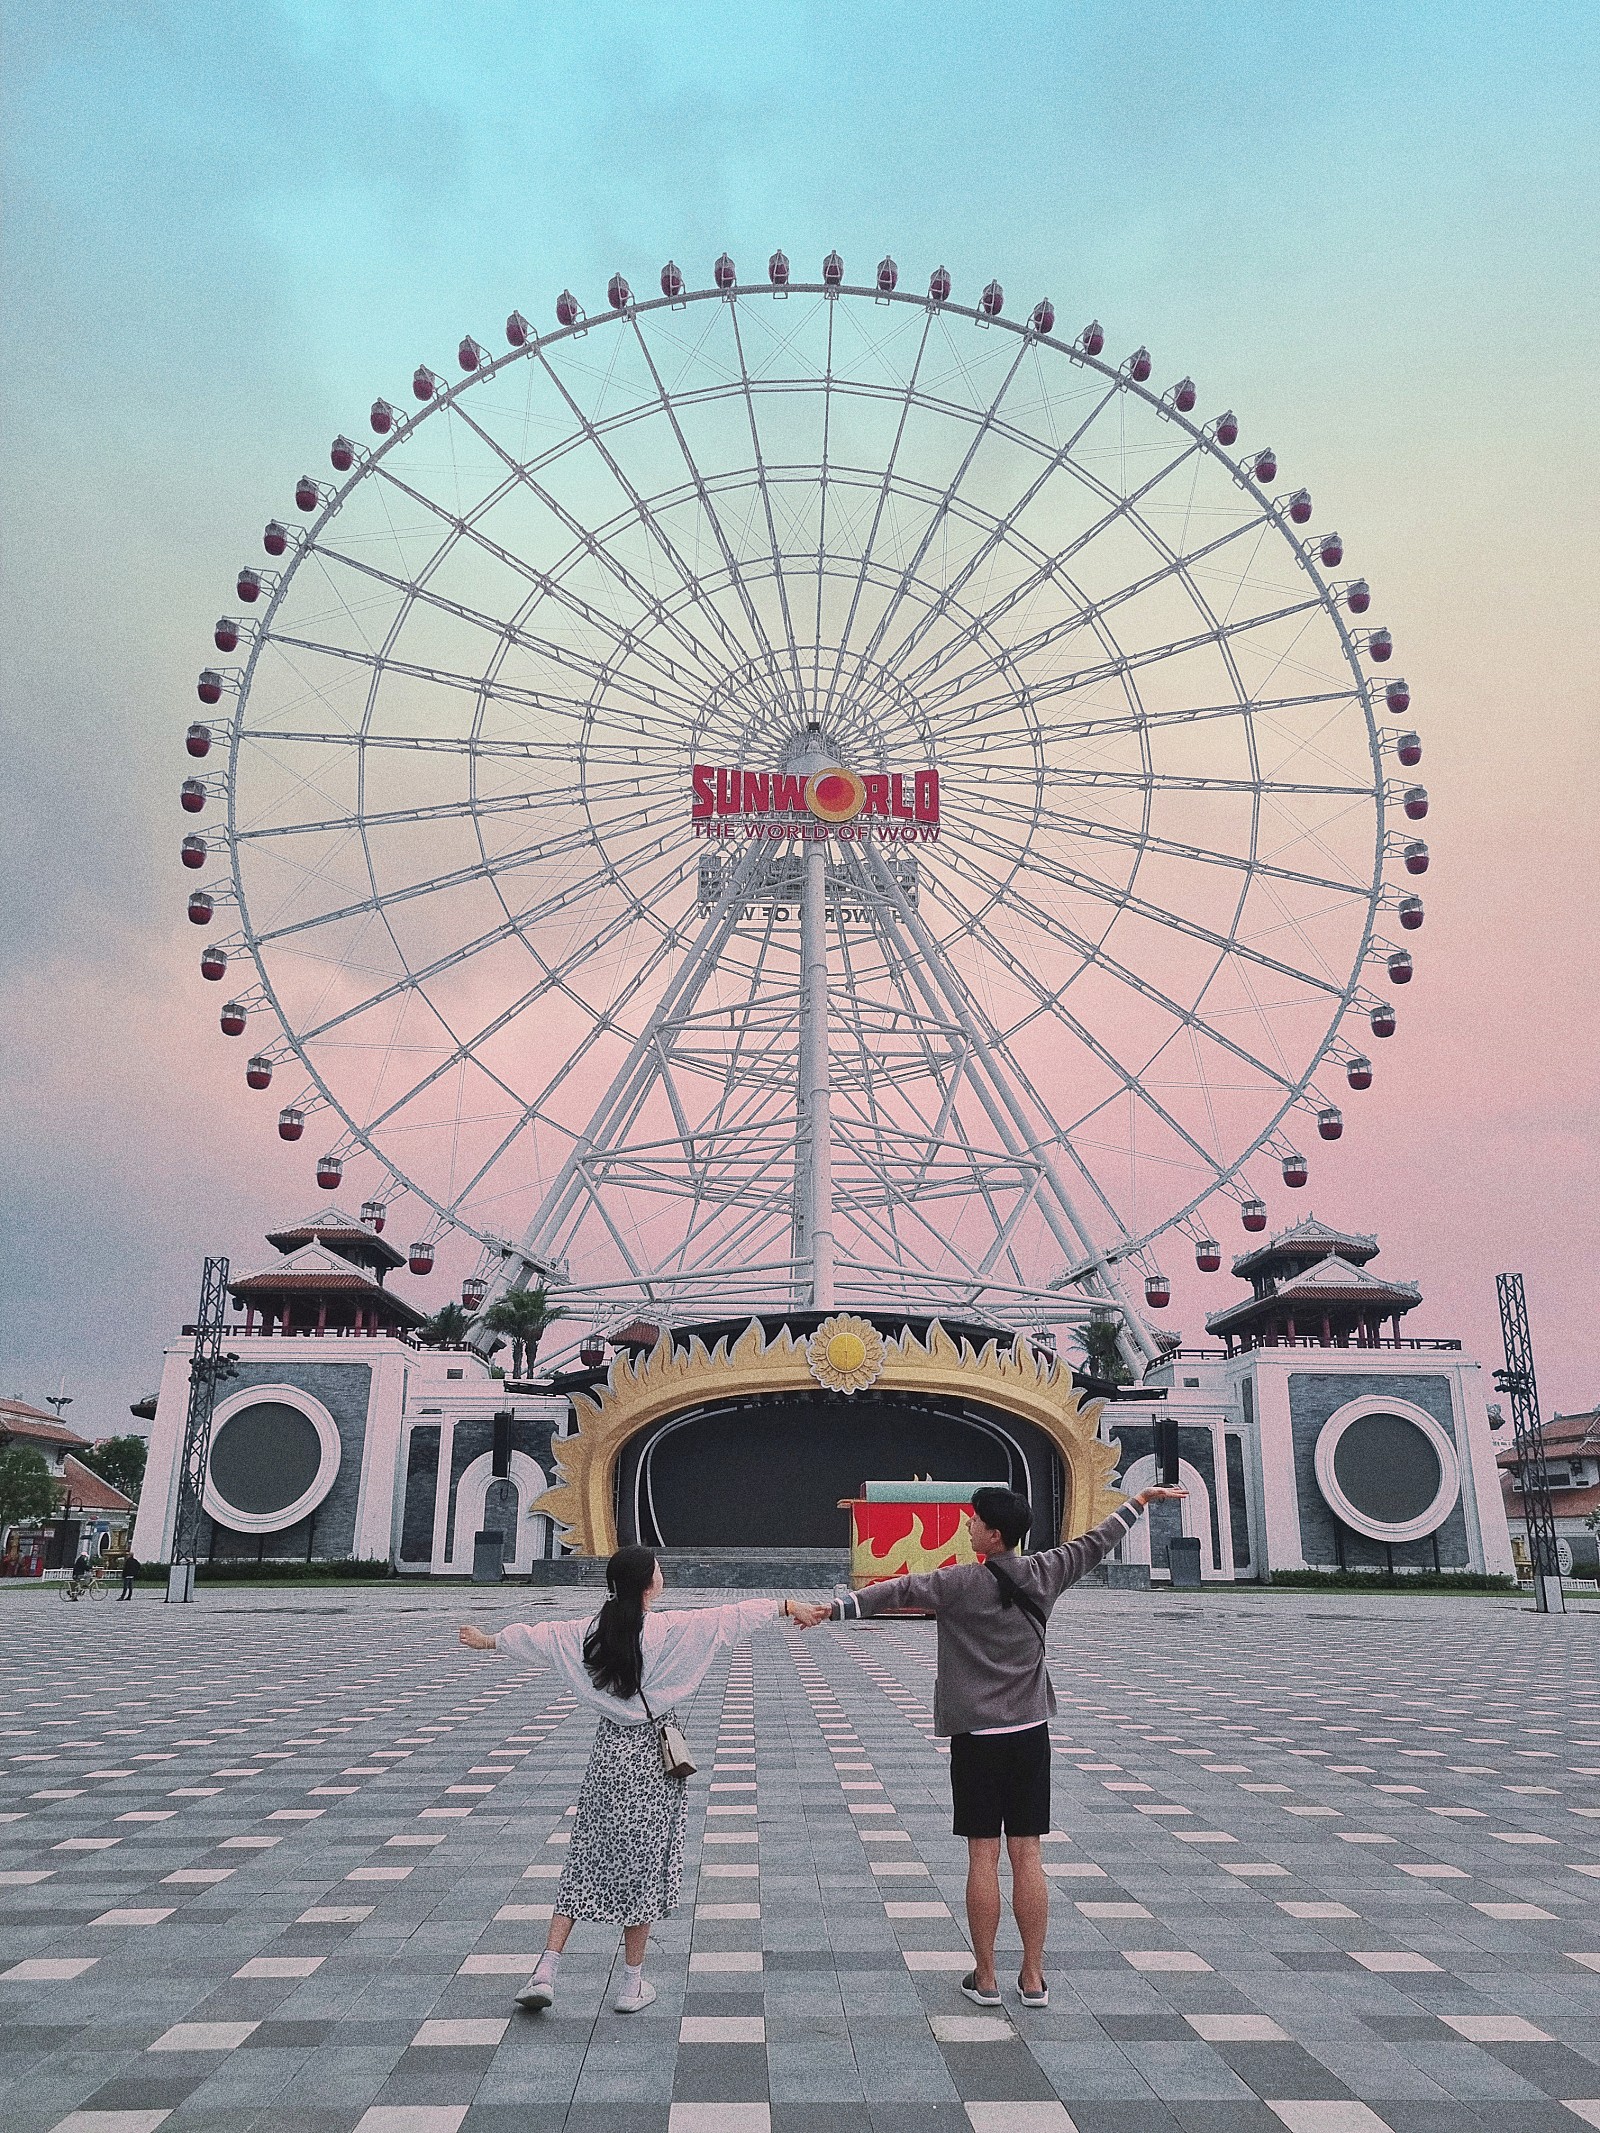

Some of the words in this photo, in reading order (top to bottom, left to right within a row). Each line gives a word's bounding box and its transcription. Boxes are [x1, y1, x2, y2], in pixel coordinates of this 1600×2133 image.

[692, 823, 736, 839] THE
[743, 823, 830, 842] WORLD
[838, 825, 869, 841] OF
[877, 826, 942, 843] WOW
